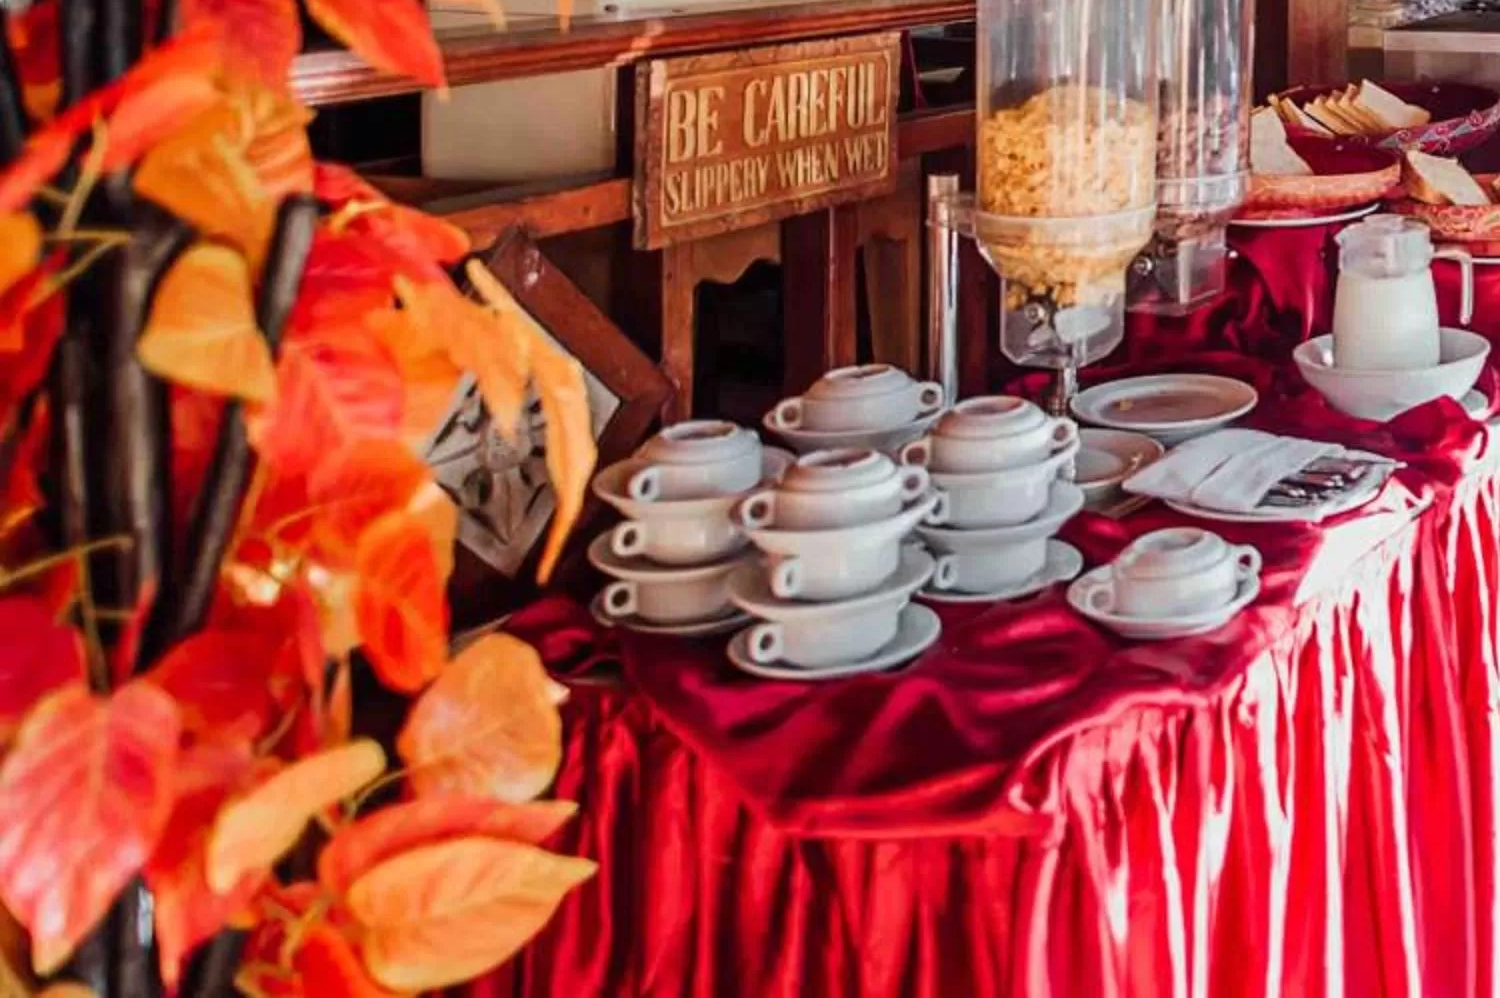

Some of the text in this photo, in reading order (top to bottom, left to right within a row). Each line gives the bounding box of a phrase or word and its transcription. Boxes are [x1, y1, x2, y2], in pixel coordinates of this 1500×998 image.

[668, 62, 885, 163] BE CAREFUL
[665, 132, 888, 214] SLIPPERY WHEN WET
